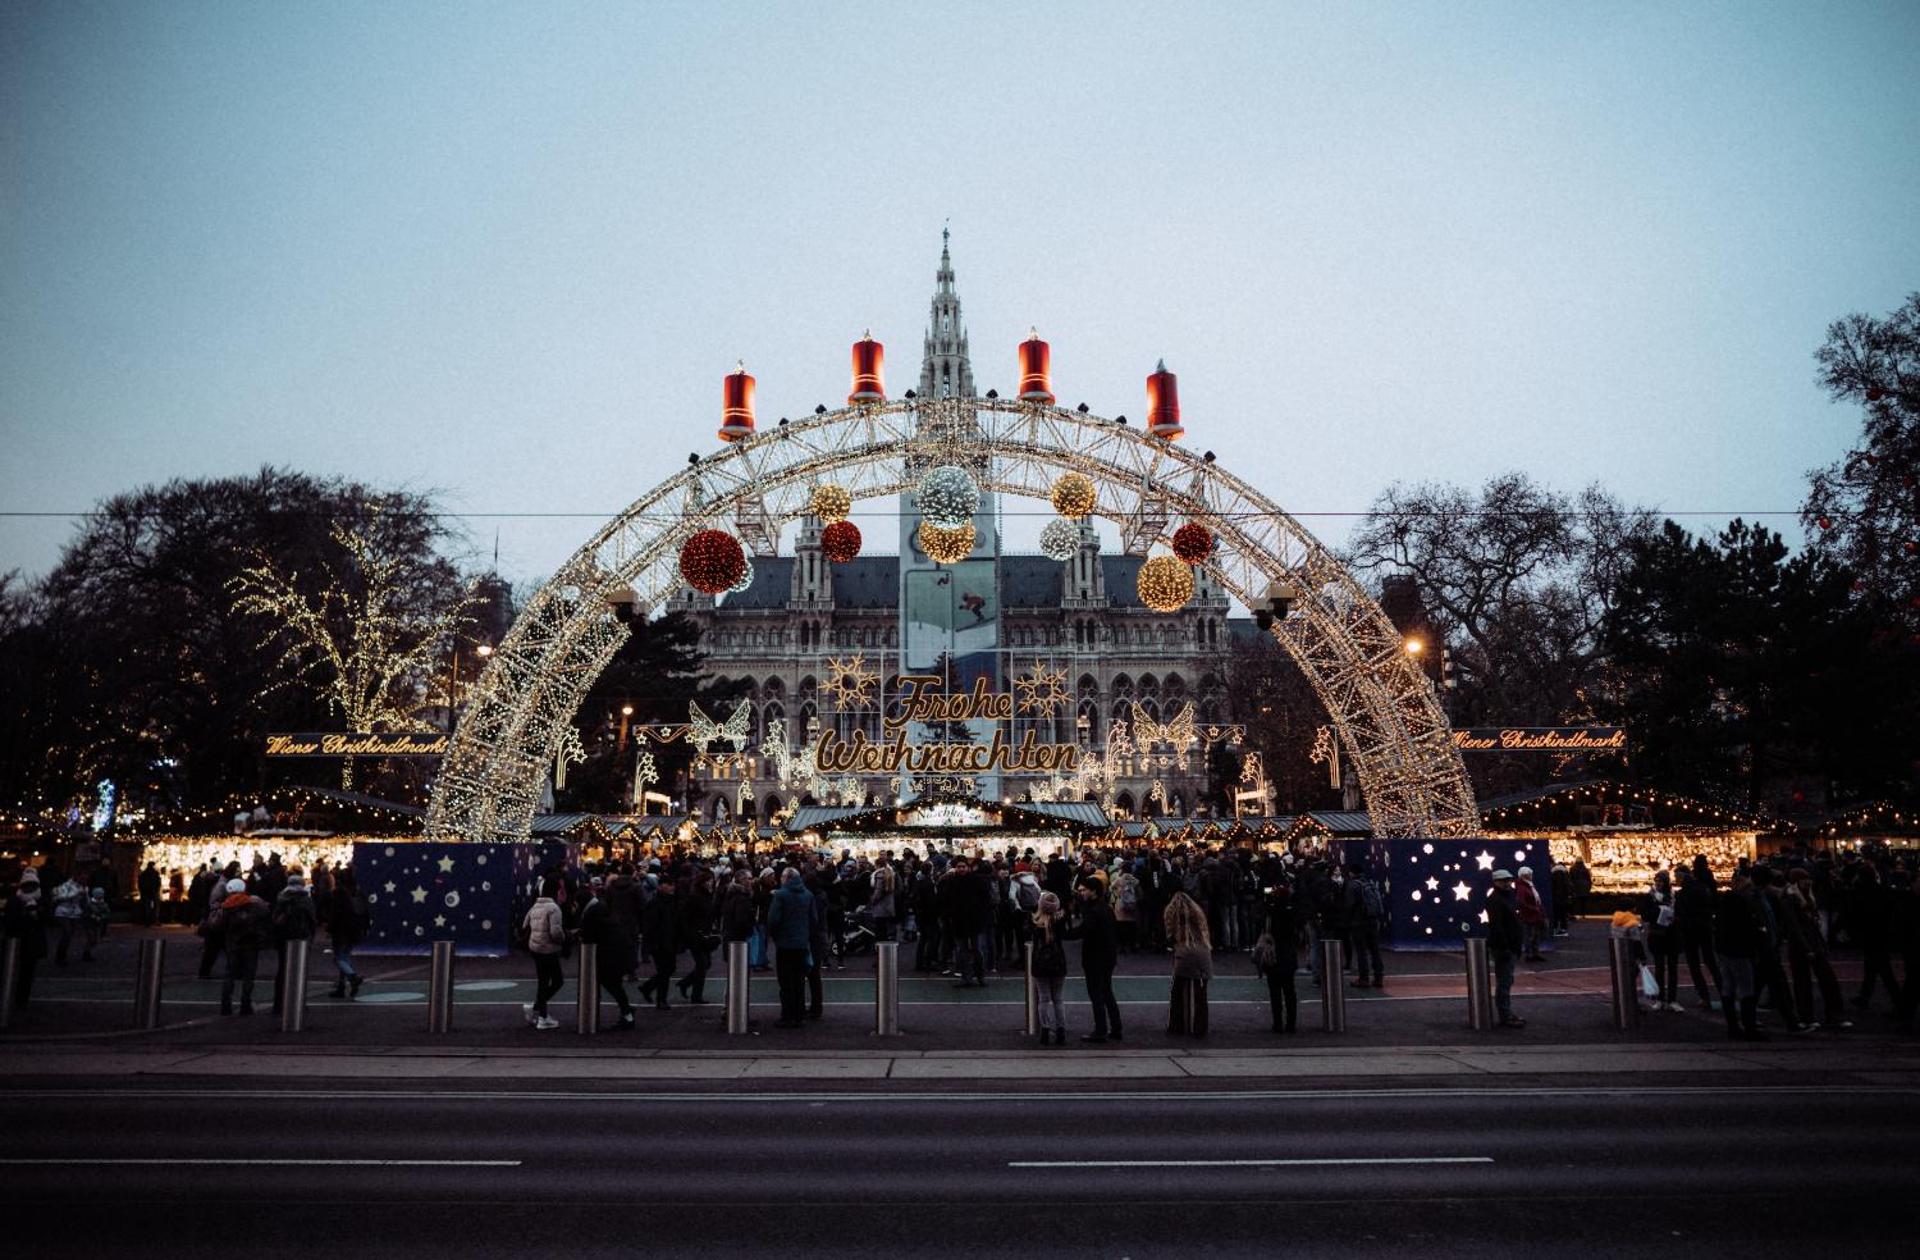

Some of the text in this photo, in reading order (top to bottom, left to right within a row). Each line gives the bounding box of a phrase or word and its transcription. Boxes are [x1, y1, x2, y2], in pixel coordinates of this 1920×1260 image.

[884, 675, 1013, 728] Frohe
[266, 734, 450, 754] Wiener Christkindlmarkt
[815, 728, 1078, 773] Weihnachten
[1500, 729, 1626, 748] Christkindlmarkt
